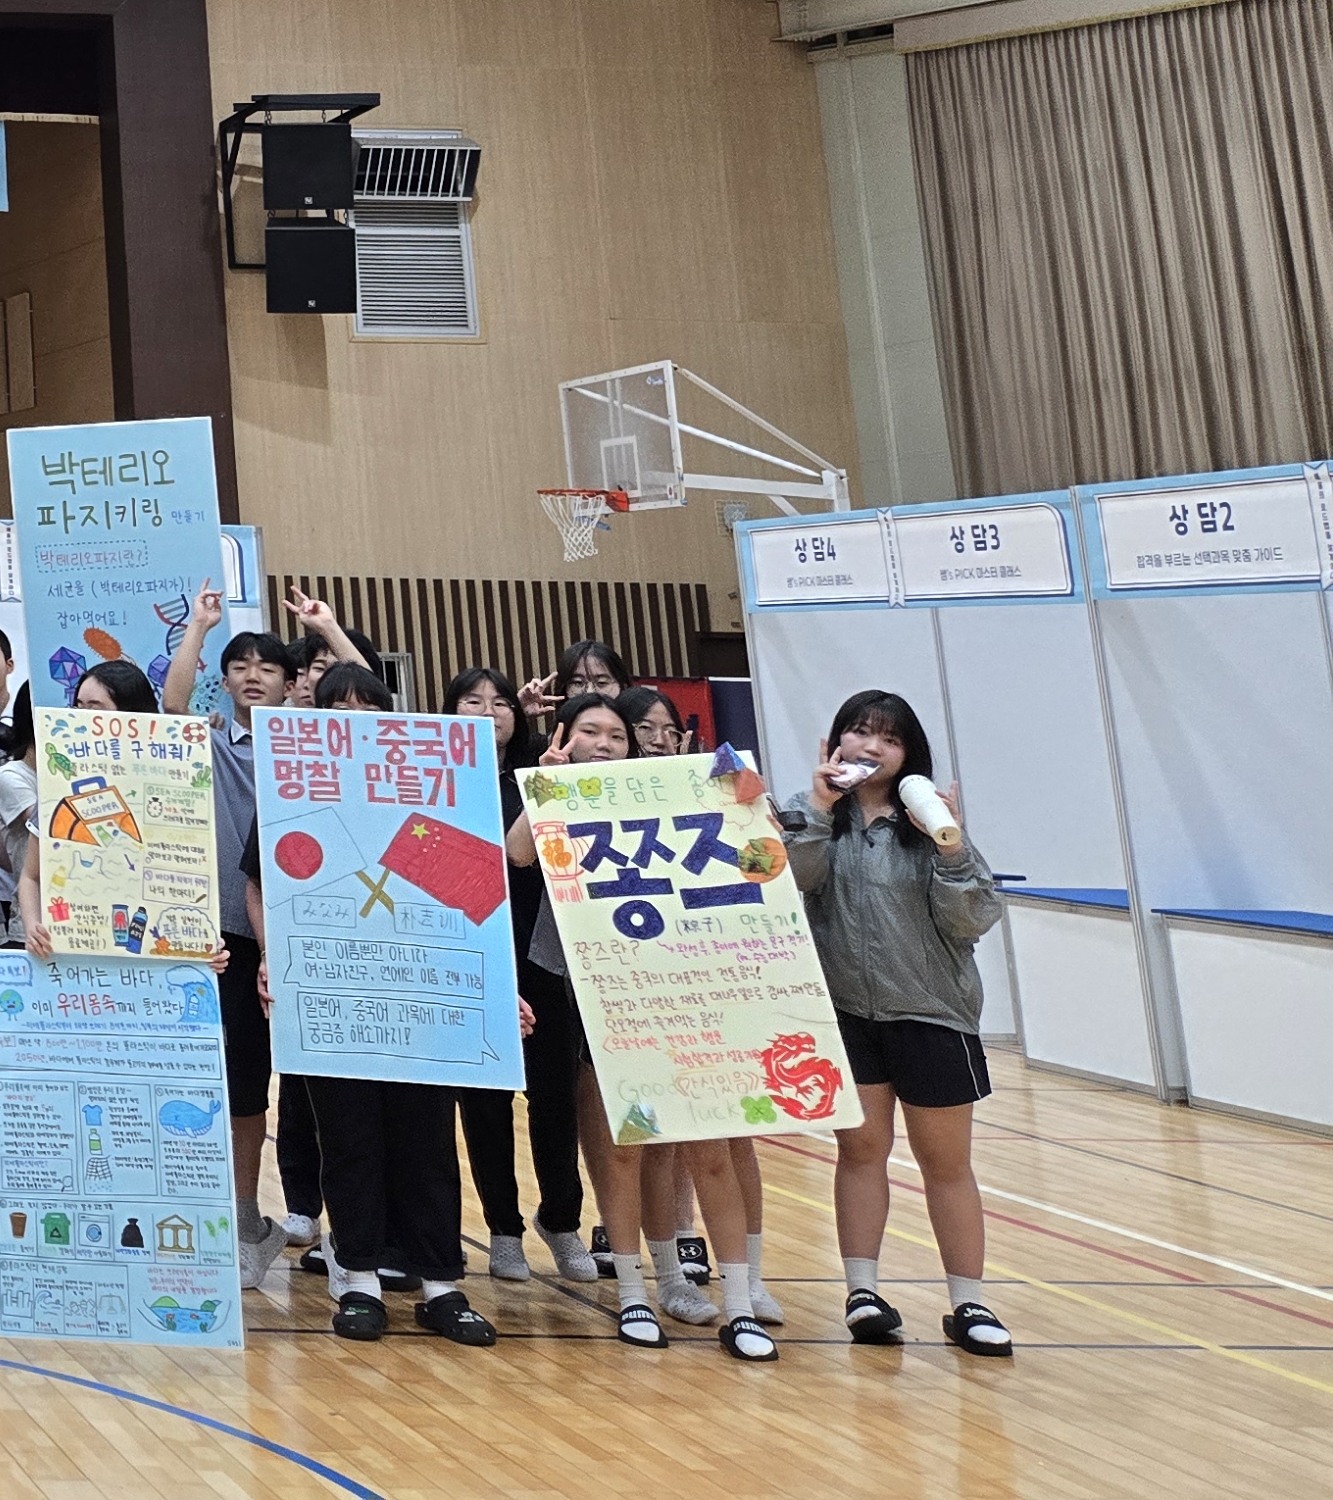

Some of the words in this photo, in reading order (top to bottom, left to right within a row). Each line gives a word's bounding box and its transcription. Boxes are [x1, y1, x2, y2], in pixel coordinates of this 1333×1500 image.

[42, 450, 175, 494] 박테리오
[37, 498, 162, 534] 파지키링
[171, 510, 205, 524] 만들기
[40, 549, 143, 569] 박테리오파지란?
[1137, 554, 1162, 569] 합격을
[1165, 553, 1191, 566] 부르는
[1194, 551, 1230, 565] 선택과목
[1233, 549, 1252, 563] 맞춤
[1254, 547, 1283, 562] 가이드
[800, 576, 814, 587] PICK
[955, 568, 974, 580] PICK
[975, 567, 998, 579] 마스터
[1000, 565, 1022, 578] 클래스
[47, 581, 84, 597] 세균을
[57, 612, 127, 628] 잡아먹어요!
[72, 738, 121, 760] 바다를
[131, 741, 192, 761] 구해줘!
[275, 760, 341, 803] 명찰
[364, 764, 456, 807] 만들기
[626, 776, 667, 803] 담은
[81, 802, 119, 818] SCOOPER
[566, 812, 765, 941] 쫑즈
[302, 943, 327, 960] 본인
[336, 941, 384, 962] 이름뿐만
[390, 947, 428, 963] 아니라
[574, 940, 640, 970] 쫑즈란?
[380, 968, 413, 984] 연예인
[420, 970, 439, 985] 이름
[465, 972, 483, 990] 가능
[631, 971, 665, 989] 중국의
[668, 970, 713, 984] 대표적인
[717, 968, 740, 982] 전통
[32, 1001, 53, 1017] 이미
[352, 1000, 389, 1023] 중국어
[397, 1004, 436, 1026] 과목에
[442, 1007, 465, 1027] 대한
[641, 997, 675, 1011] 다양한
[308, 1025, 344, 1044] 궁금증
[350, 1025, 411, 1046] 해소까지!
